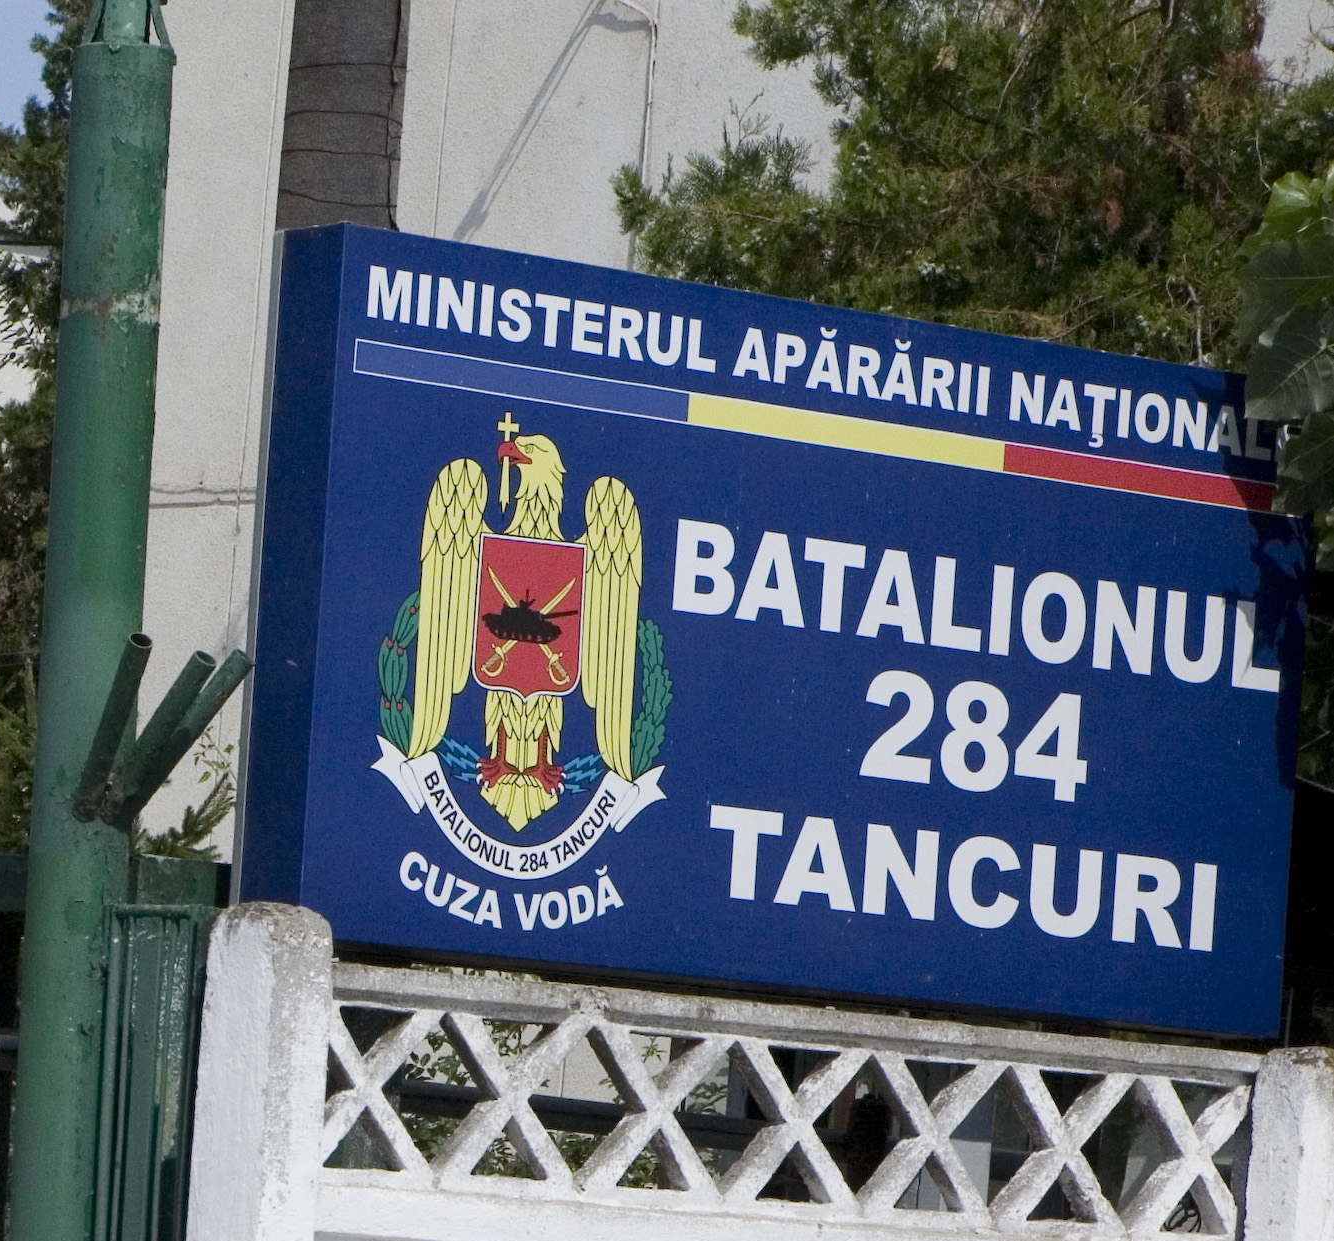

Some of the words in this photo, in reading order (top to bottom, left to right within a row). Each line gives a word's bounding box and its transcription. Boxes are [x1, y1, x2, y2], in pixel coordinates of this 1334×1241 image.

[366, 264, 716, 374] MINISTERUL
[733, 326, 991, 417] APĂRĂRII
[1008, 370, 1291, 462] NAŢIONAL
[672, 518, 1282, 693] BATALIONUL
[859, 669, 1088, 802] 284
[399, 851, 503, 930] CUZA
[514, 865, 625, 931] VODĂ
[423, 770, 515, 872] BATALIONUL
[519, 852, 549, 873] 284
[550, 788, 617, 865] TANCURI
[709, 803, 1219, 953] TANCURI
